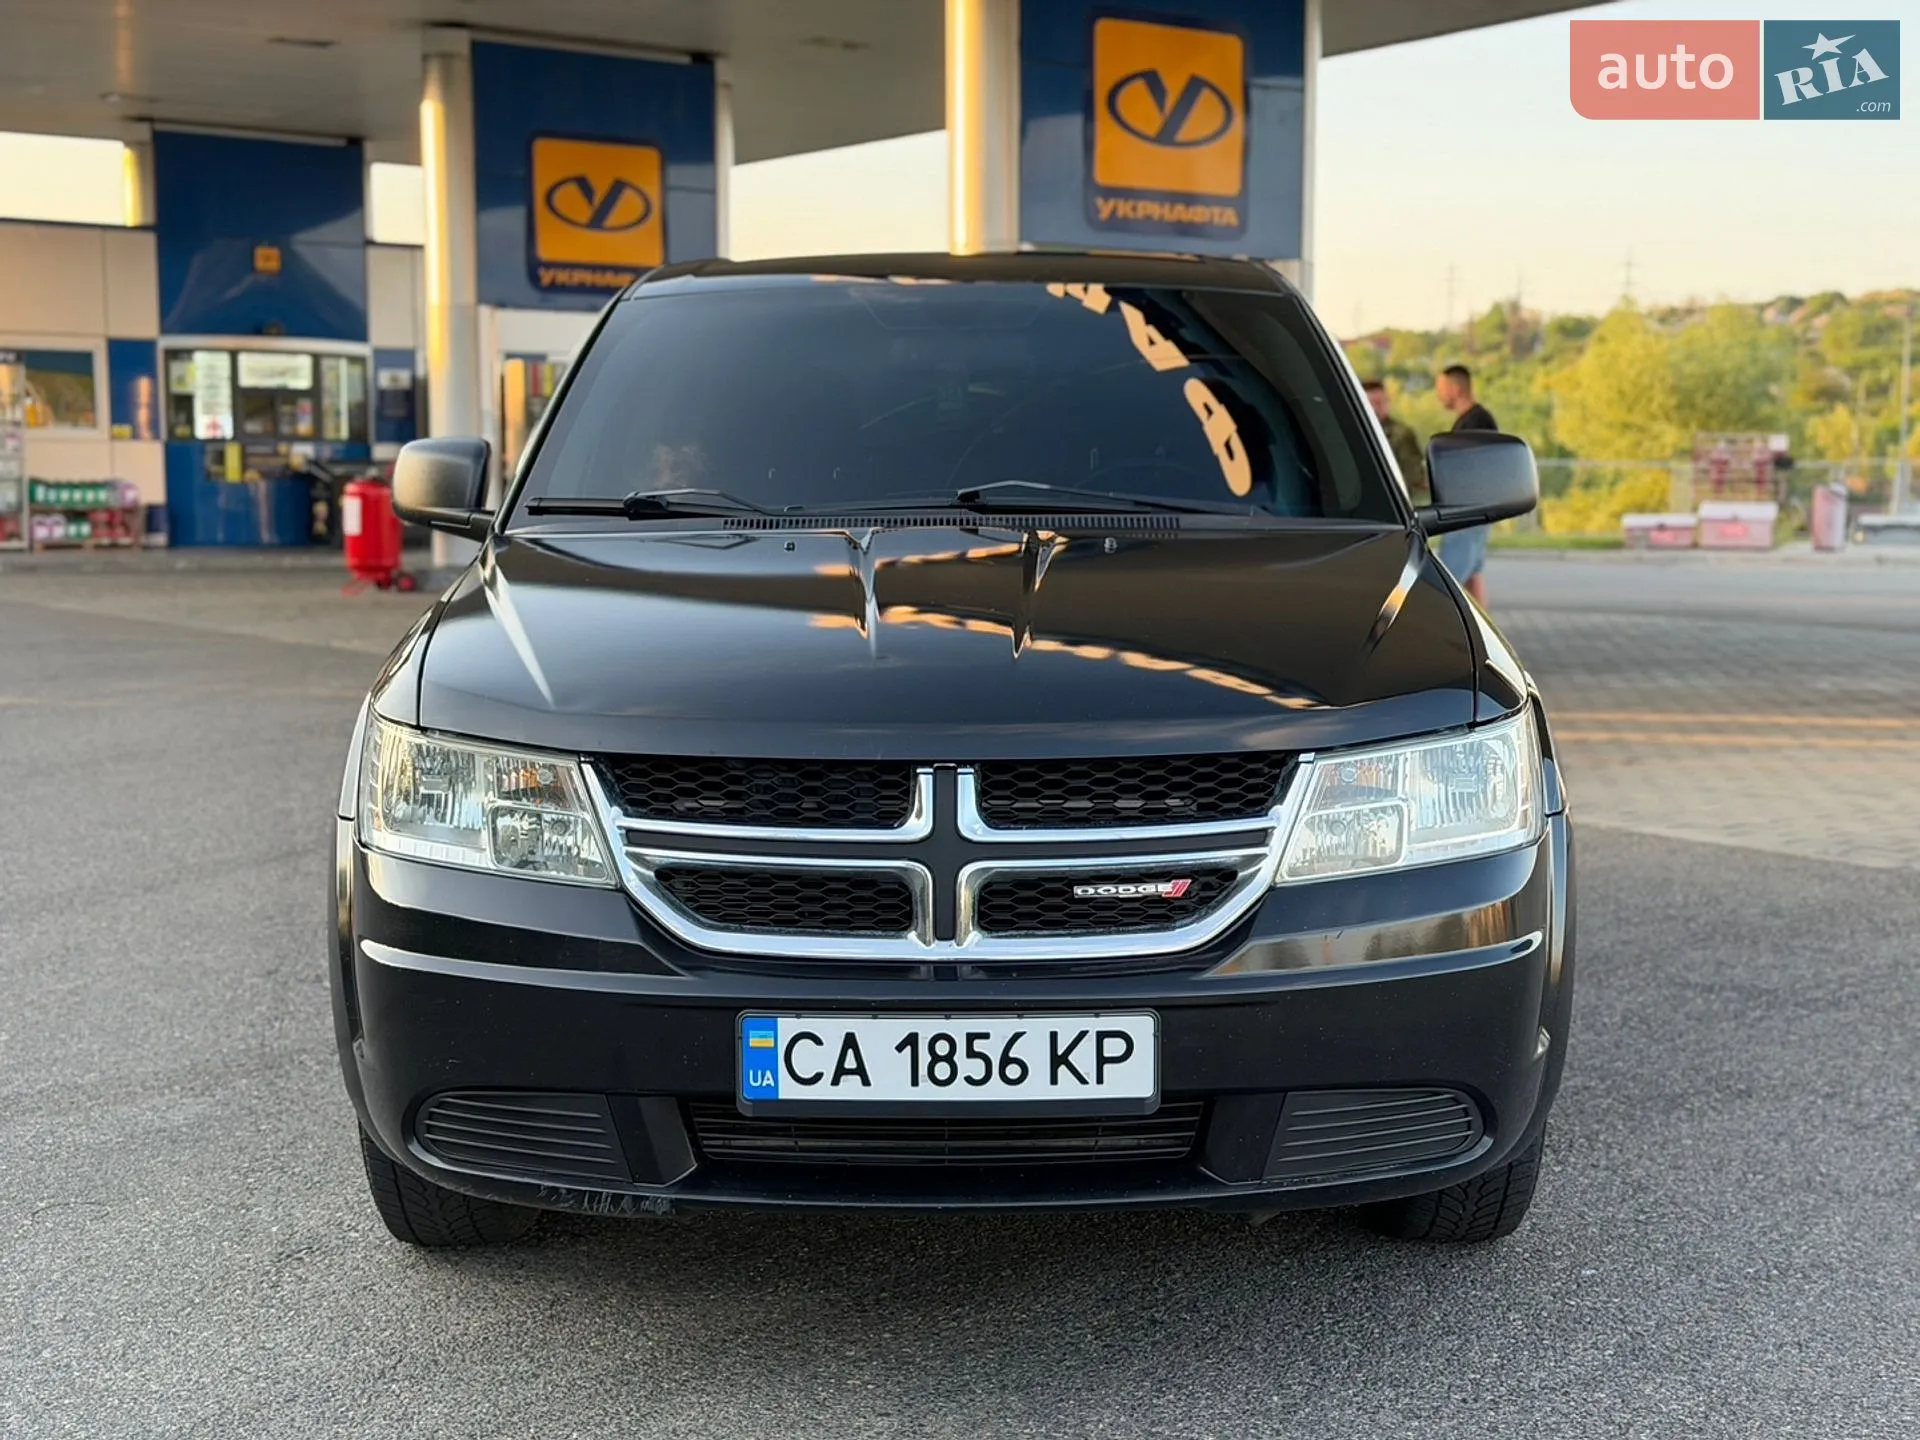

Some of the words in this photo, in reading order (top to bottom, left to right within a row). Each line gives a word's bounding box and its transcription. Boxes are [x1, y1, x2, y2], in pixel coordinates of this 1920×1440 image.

[1095, 197, 1239, 227] УКРНАФТА
[1074, 883, 1173, 898] DODGE
[783, 1030, 872, 1088] CA
[894, 1030, 1030, 1088] 1856
[1048, 1029, 1136, 1087] KP
[749, 1070, 775, 1088] UA
